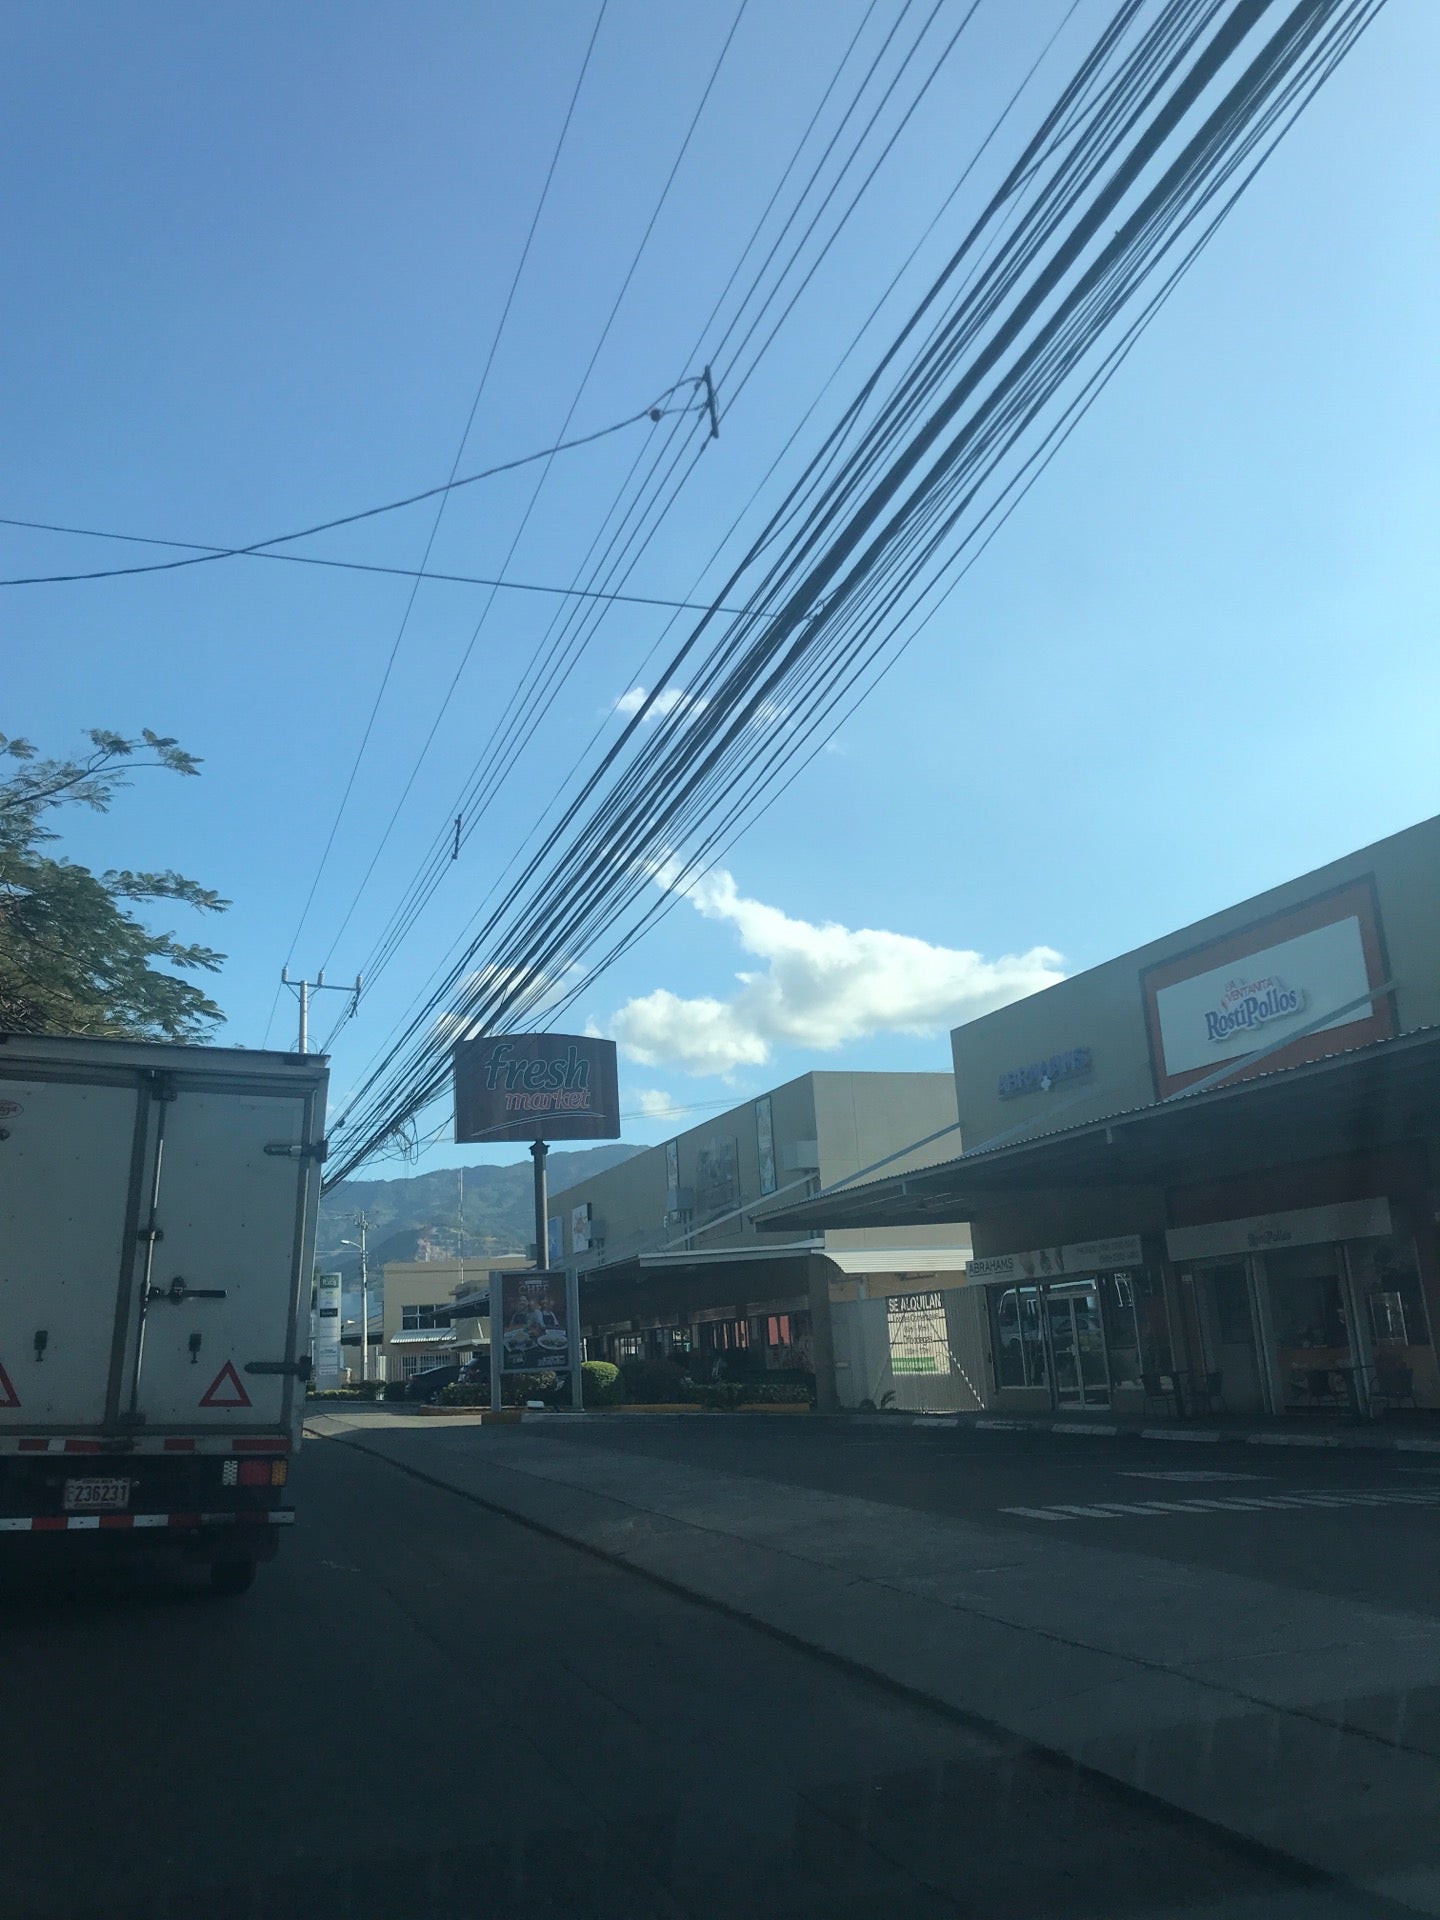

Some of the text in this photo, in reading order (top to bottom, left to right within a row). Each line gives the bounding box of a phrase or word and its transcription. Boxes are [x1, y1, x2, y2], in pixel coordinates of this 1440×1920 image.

[1204, 988, 1298, 1040] RostíPollos
[484, 1043, 590, 1090] fresh
[505, 1088, 592, 1111] market
[969, 1257, 1014, 1274] ABRAHAMS
[889, 1292, 942, 1313] SE ALQUILAN
[74, 1485, 127, 1502] 236231
